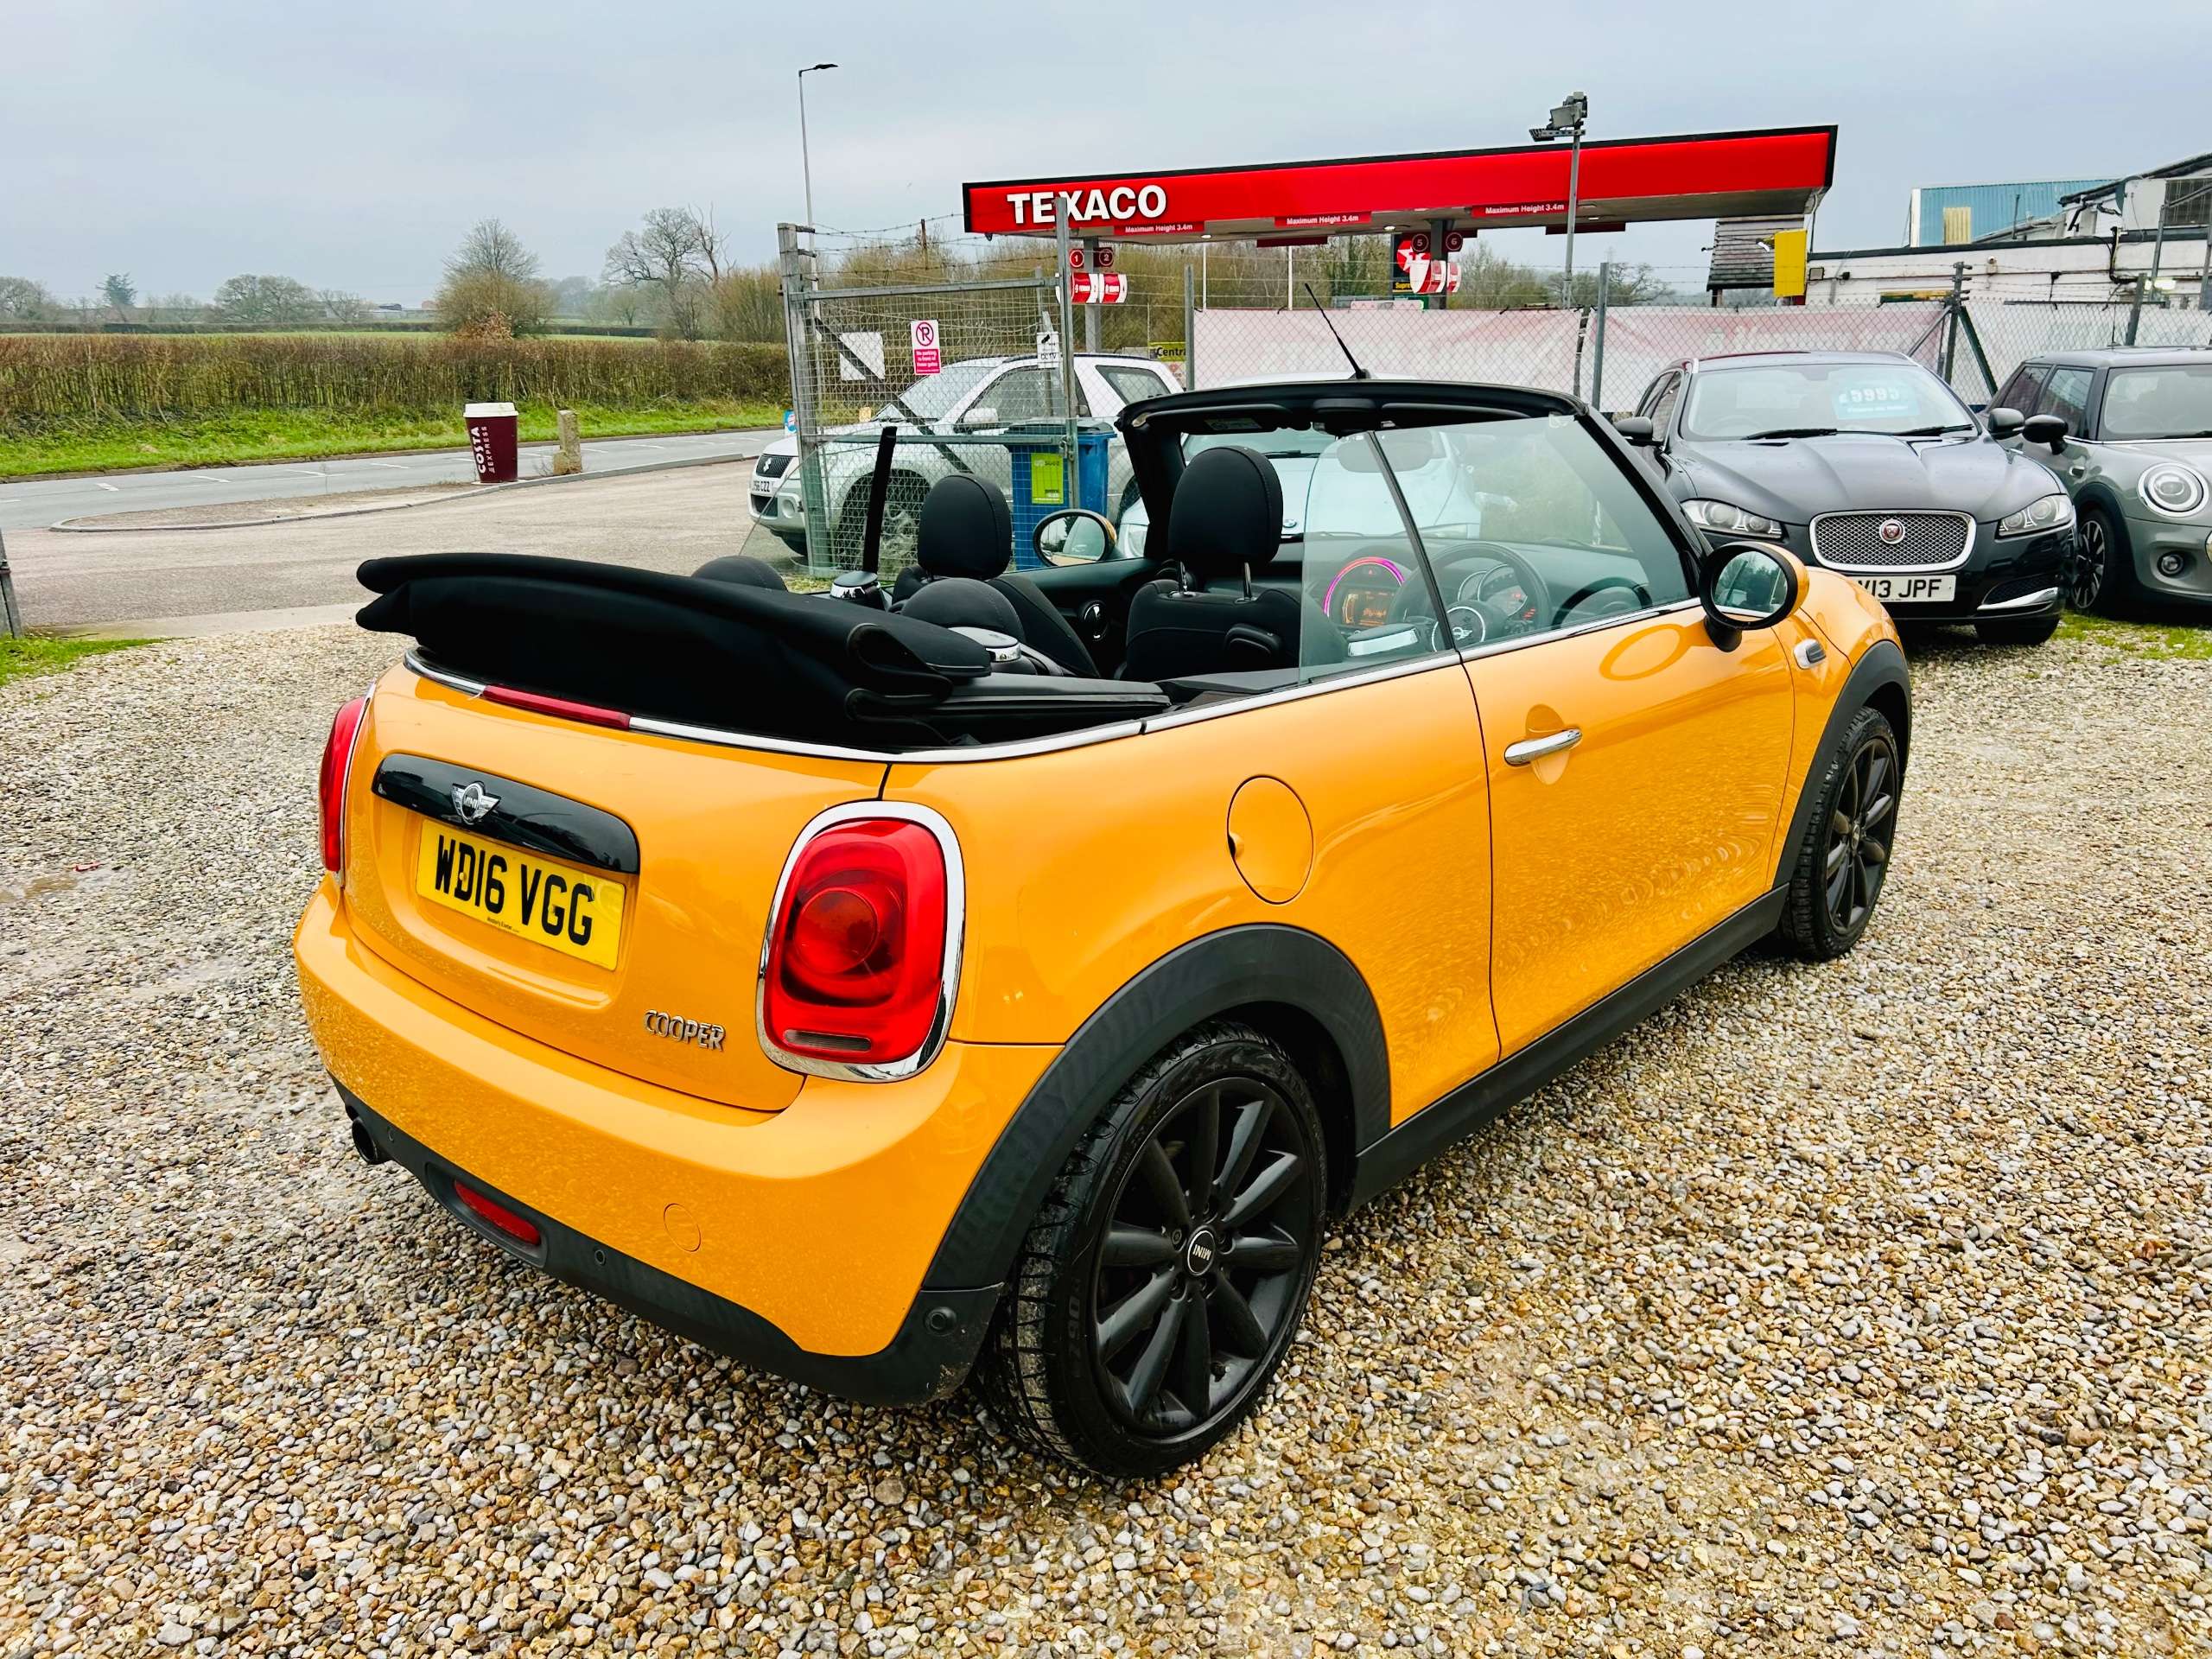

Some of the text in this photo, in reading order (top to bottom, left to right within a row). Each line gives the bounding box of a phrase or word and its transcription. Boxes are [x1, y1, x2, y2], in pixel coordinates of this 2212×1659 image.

[1007, 185, 1166, 224] TEXACO
[1521, 204, 1544, 213] Height
[1155, 224, 1176, 232] Height
[1319, 215, 1341, 225] Height
[470, 427, 486, 474] COSTA
[481, 426, 494, 467] EXPRESS
[1898, 579, 1942, 598] JPF
[435, 835, 595, 946] WD16 VGG
[643, 1009, 726, 1052] COOPER
[1192, 1244, 1212, 1261] MINI
